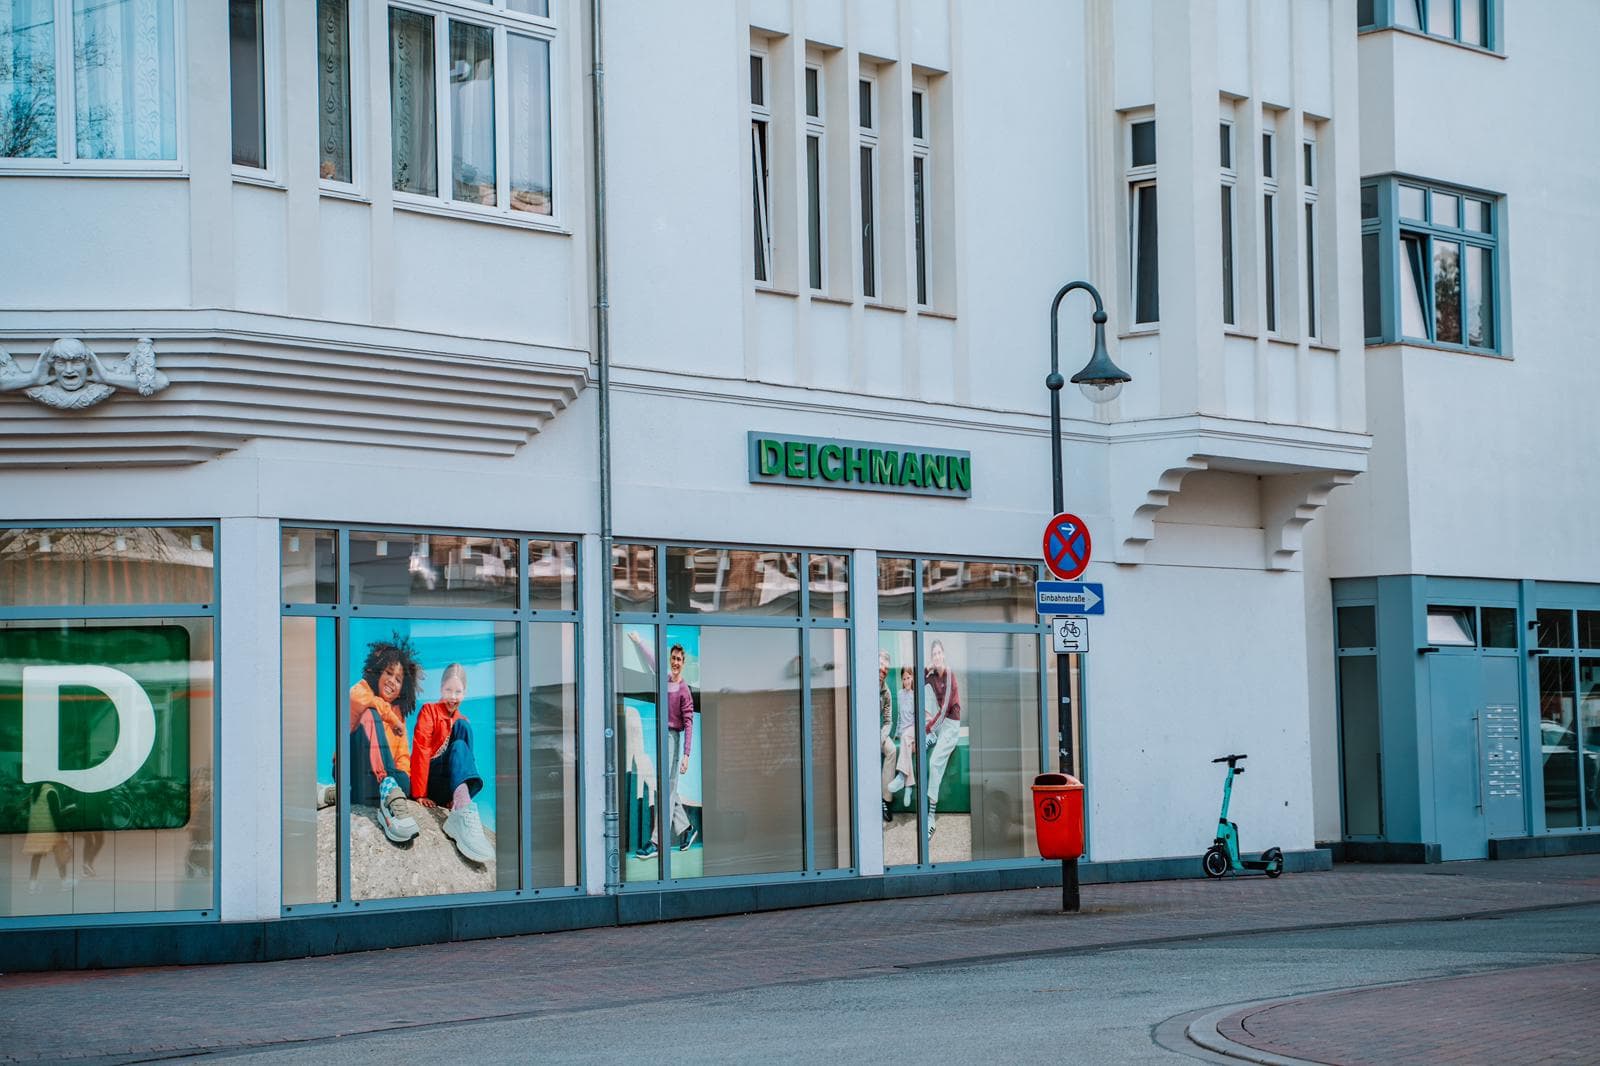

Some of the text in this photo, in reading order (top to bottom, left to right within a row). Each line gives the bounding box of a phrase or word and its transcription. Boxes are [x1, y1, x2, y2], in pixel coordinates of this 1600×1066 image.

[758, 439, 971, 490] DEICHMANN
[1040, 593, 1086, 603] Einbahnstraße
[22, 665, 156, 793] D
